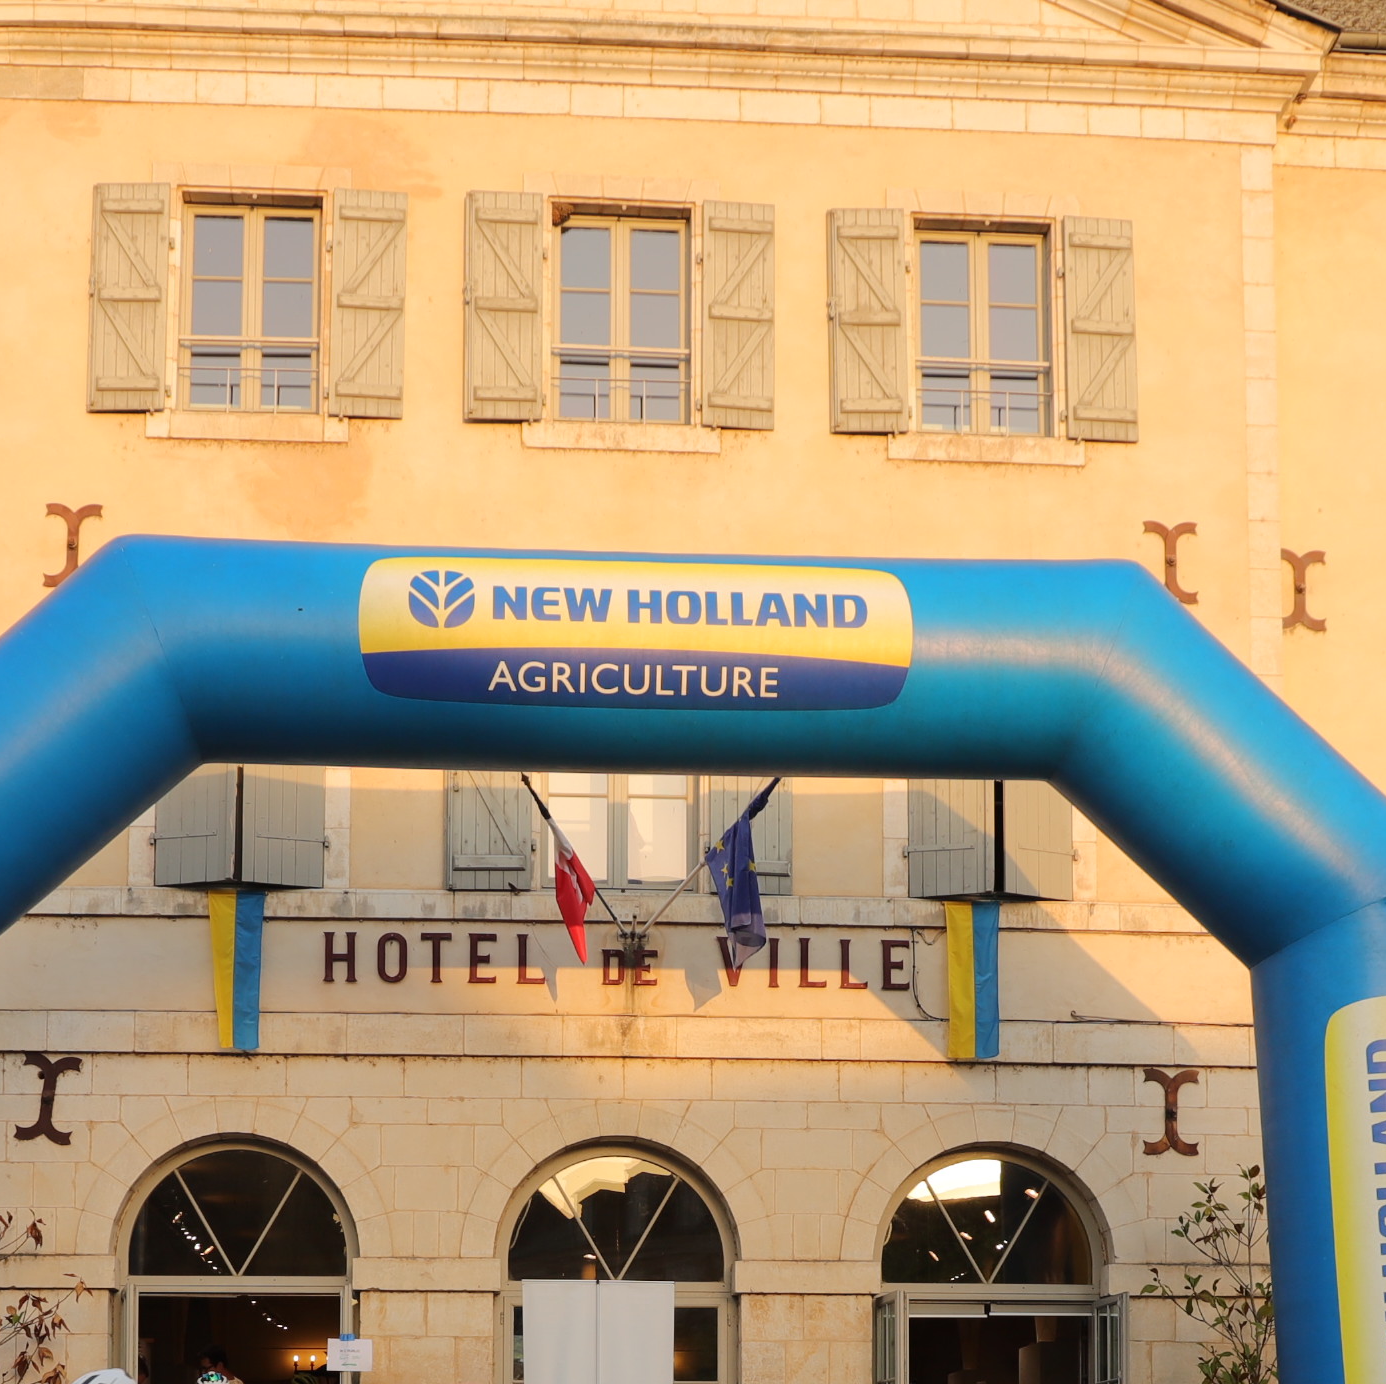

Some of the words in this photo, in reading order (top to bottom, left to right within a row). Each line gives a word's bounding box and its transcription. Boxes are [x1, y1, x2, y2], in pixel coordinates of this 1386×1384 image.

[492, 585, 612, 622] NEW
[626, 588, 868, 629] HOLLAND
[488, 660, 779, 698] AGRICULTURE
[322, 931, 548, 984] HOTEL
[601, 948, 658, 987] DE
[716, 935, 911, 991] VILLE
